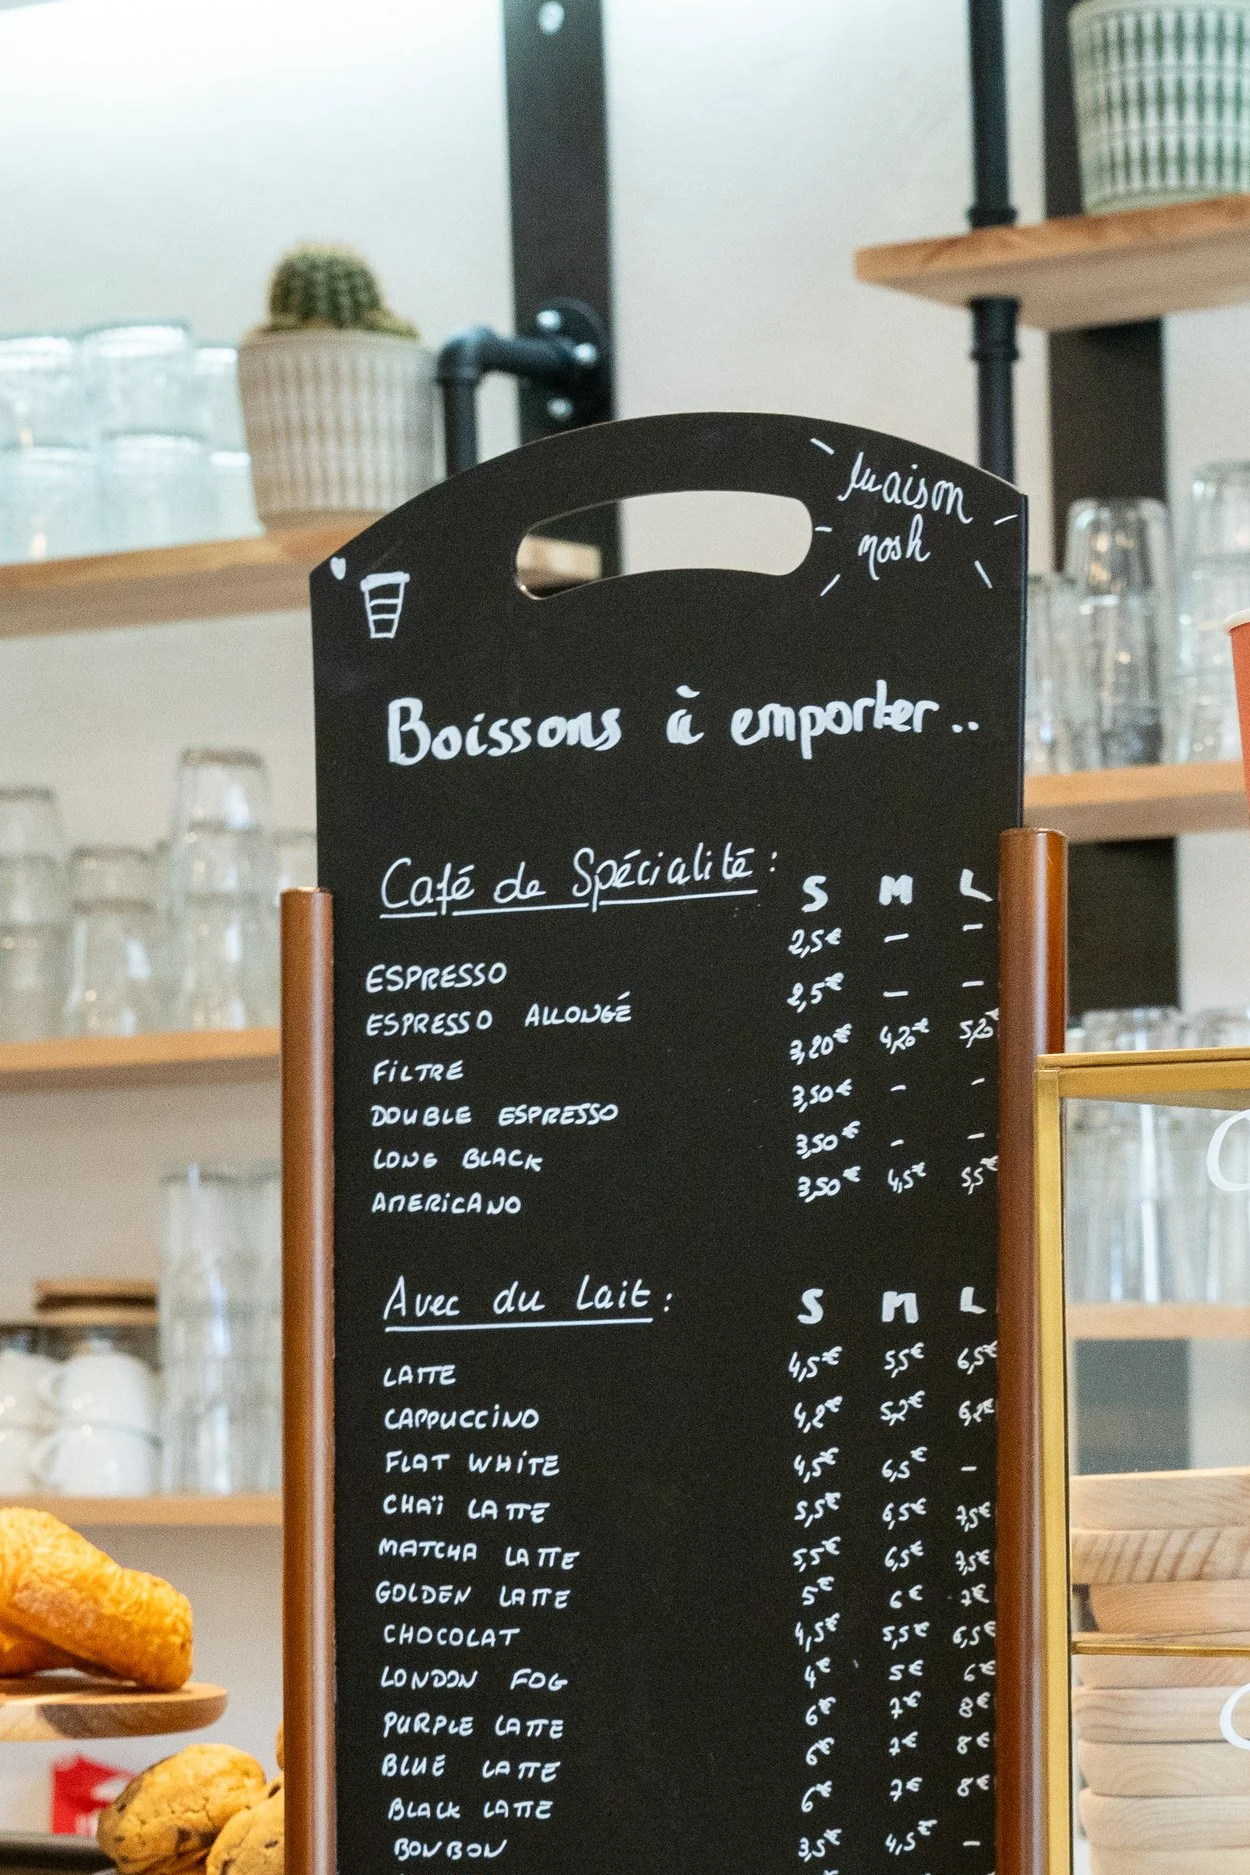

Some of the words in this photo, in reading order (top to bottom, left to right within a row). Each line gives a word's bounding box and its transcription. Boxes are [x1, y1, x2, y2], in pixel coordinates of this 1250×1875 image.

[835, 450, 974, 525] maison
[856, 511, 931, 581] nosh
[386, 695, 622, 767] Boissons
[664, 683, 705, 746] à
[380, 856, 475, 916] Café
[491, 859, 547, 904] de
[799, 873, 829, 914] S
[877, 873, 914, 907] M
[958, 867, 994, 903] L
[364, 960, 508, 994] ESPRESSO
[364, 1008, 494, 1037] ESPRESSO
[523, 989, 632, 1027] ALLONGÉ
[369, 1103, 473, 1128] DOUBLE
[496, 1101, 619, 1127] ESPRESSO
[372, 1147, 438, 1170] LONG
[460, 1146, 544, 1173] BLACK
[381, 1273, 461, 1321] Avec
[491, 1279, 546, 1315] du
[795, 1286, 824, 1325] S
[880, 1289, 920, 1324] M
[958, 1285, 988, 1315] L
[381, 1363, 457, 1388] LATTE
[384, 1448, 451, 1474] FLAT
[466, 1496, 551, 1524] LATTE
[377, 1536, 478, 1563] MATCHA
[503, 1544, 581, 1571] LATTE
[373, 1579, 472, 1606] GOLDEN
[498, 1584, 571, 1610] LATTE
[382, 1621, 521, 1648] CHOCOLAT
[379, 1664, 479, 1691] LONDON
[508, 1666, 569, 1692] FOG
[381, 1709, 474, 1739] PURPLE
[493, 1713, 564, 1740] LATTE
[380, 1751, 446, 1778] BLUE
[480, 1758, 562, 1784] LATTE
[386, 1796, 461, 1822] BLACK
[482, 1798, 554, 1820] LATTE
[392, 1836, 508, 1862] BONBON
